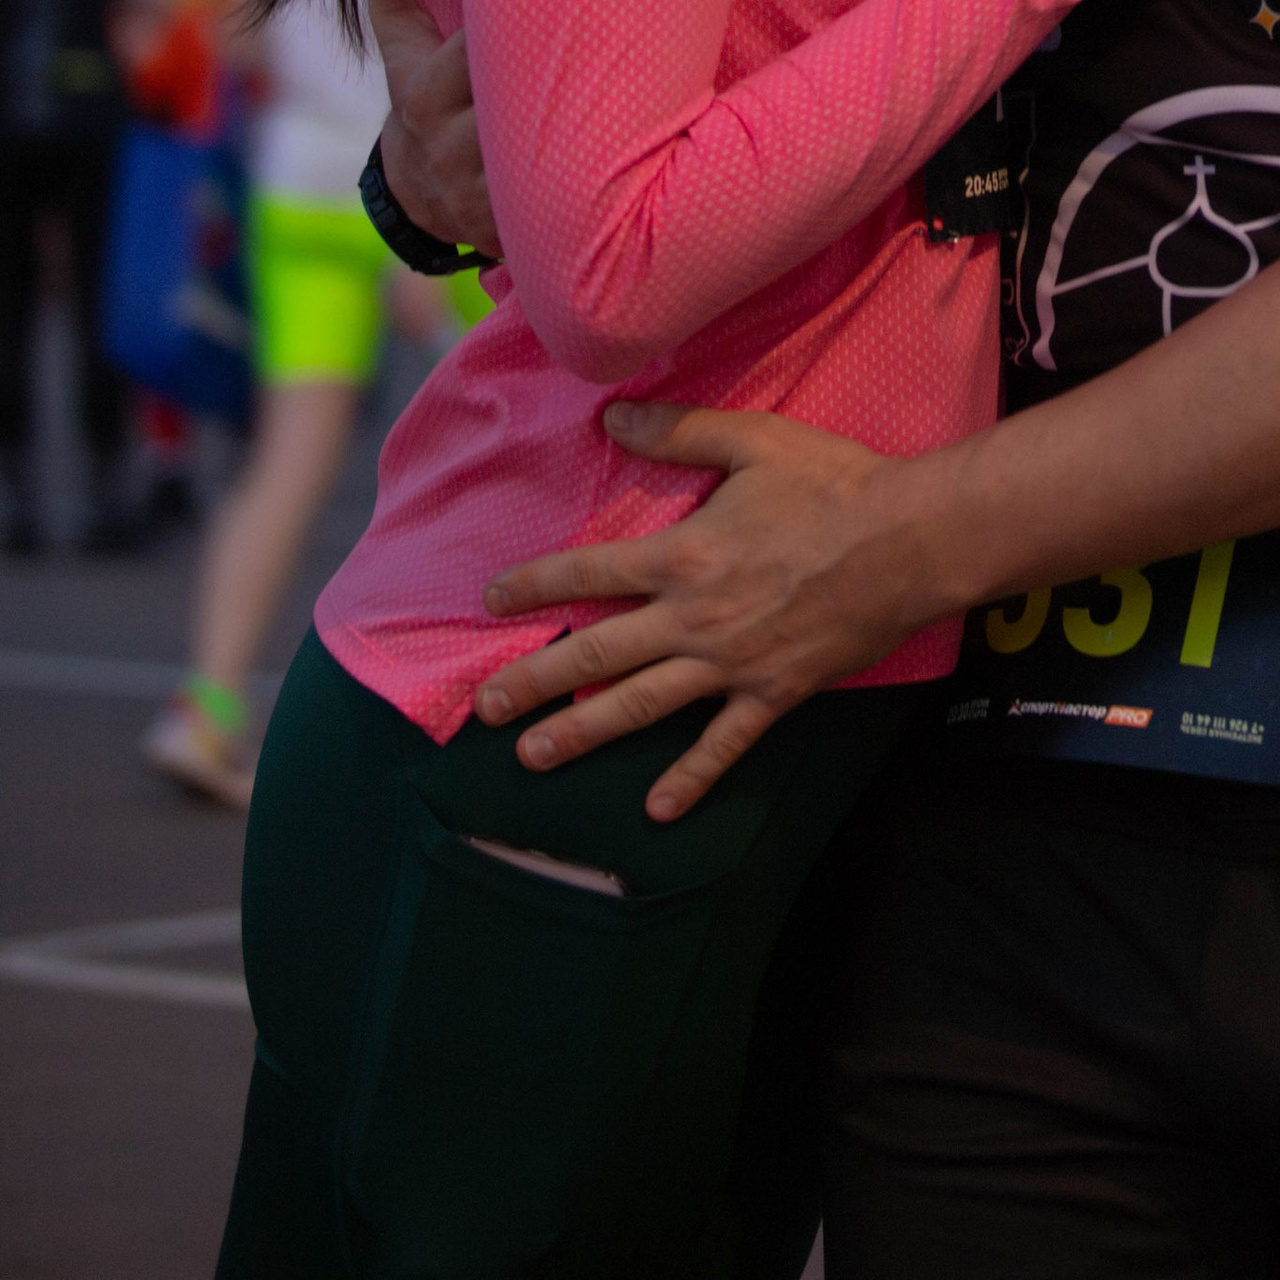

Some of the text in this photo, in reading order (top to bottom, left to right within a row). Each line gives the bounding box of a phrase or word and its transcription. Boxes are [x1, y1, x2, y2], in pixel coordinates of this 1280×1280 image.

[964, 169, 999, 199] 20:45
[1109, 708, 1148, 724] PRO
[1181, 711, 1193, 725] 10
[1213, 716, 1226, 730] 111
